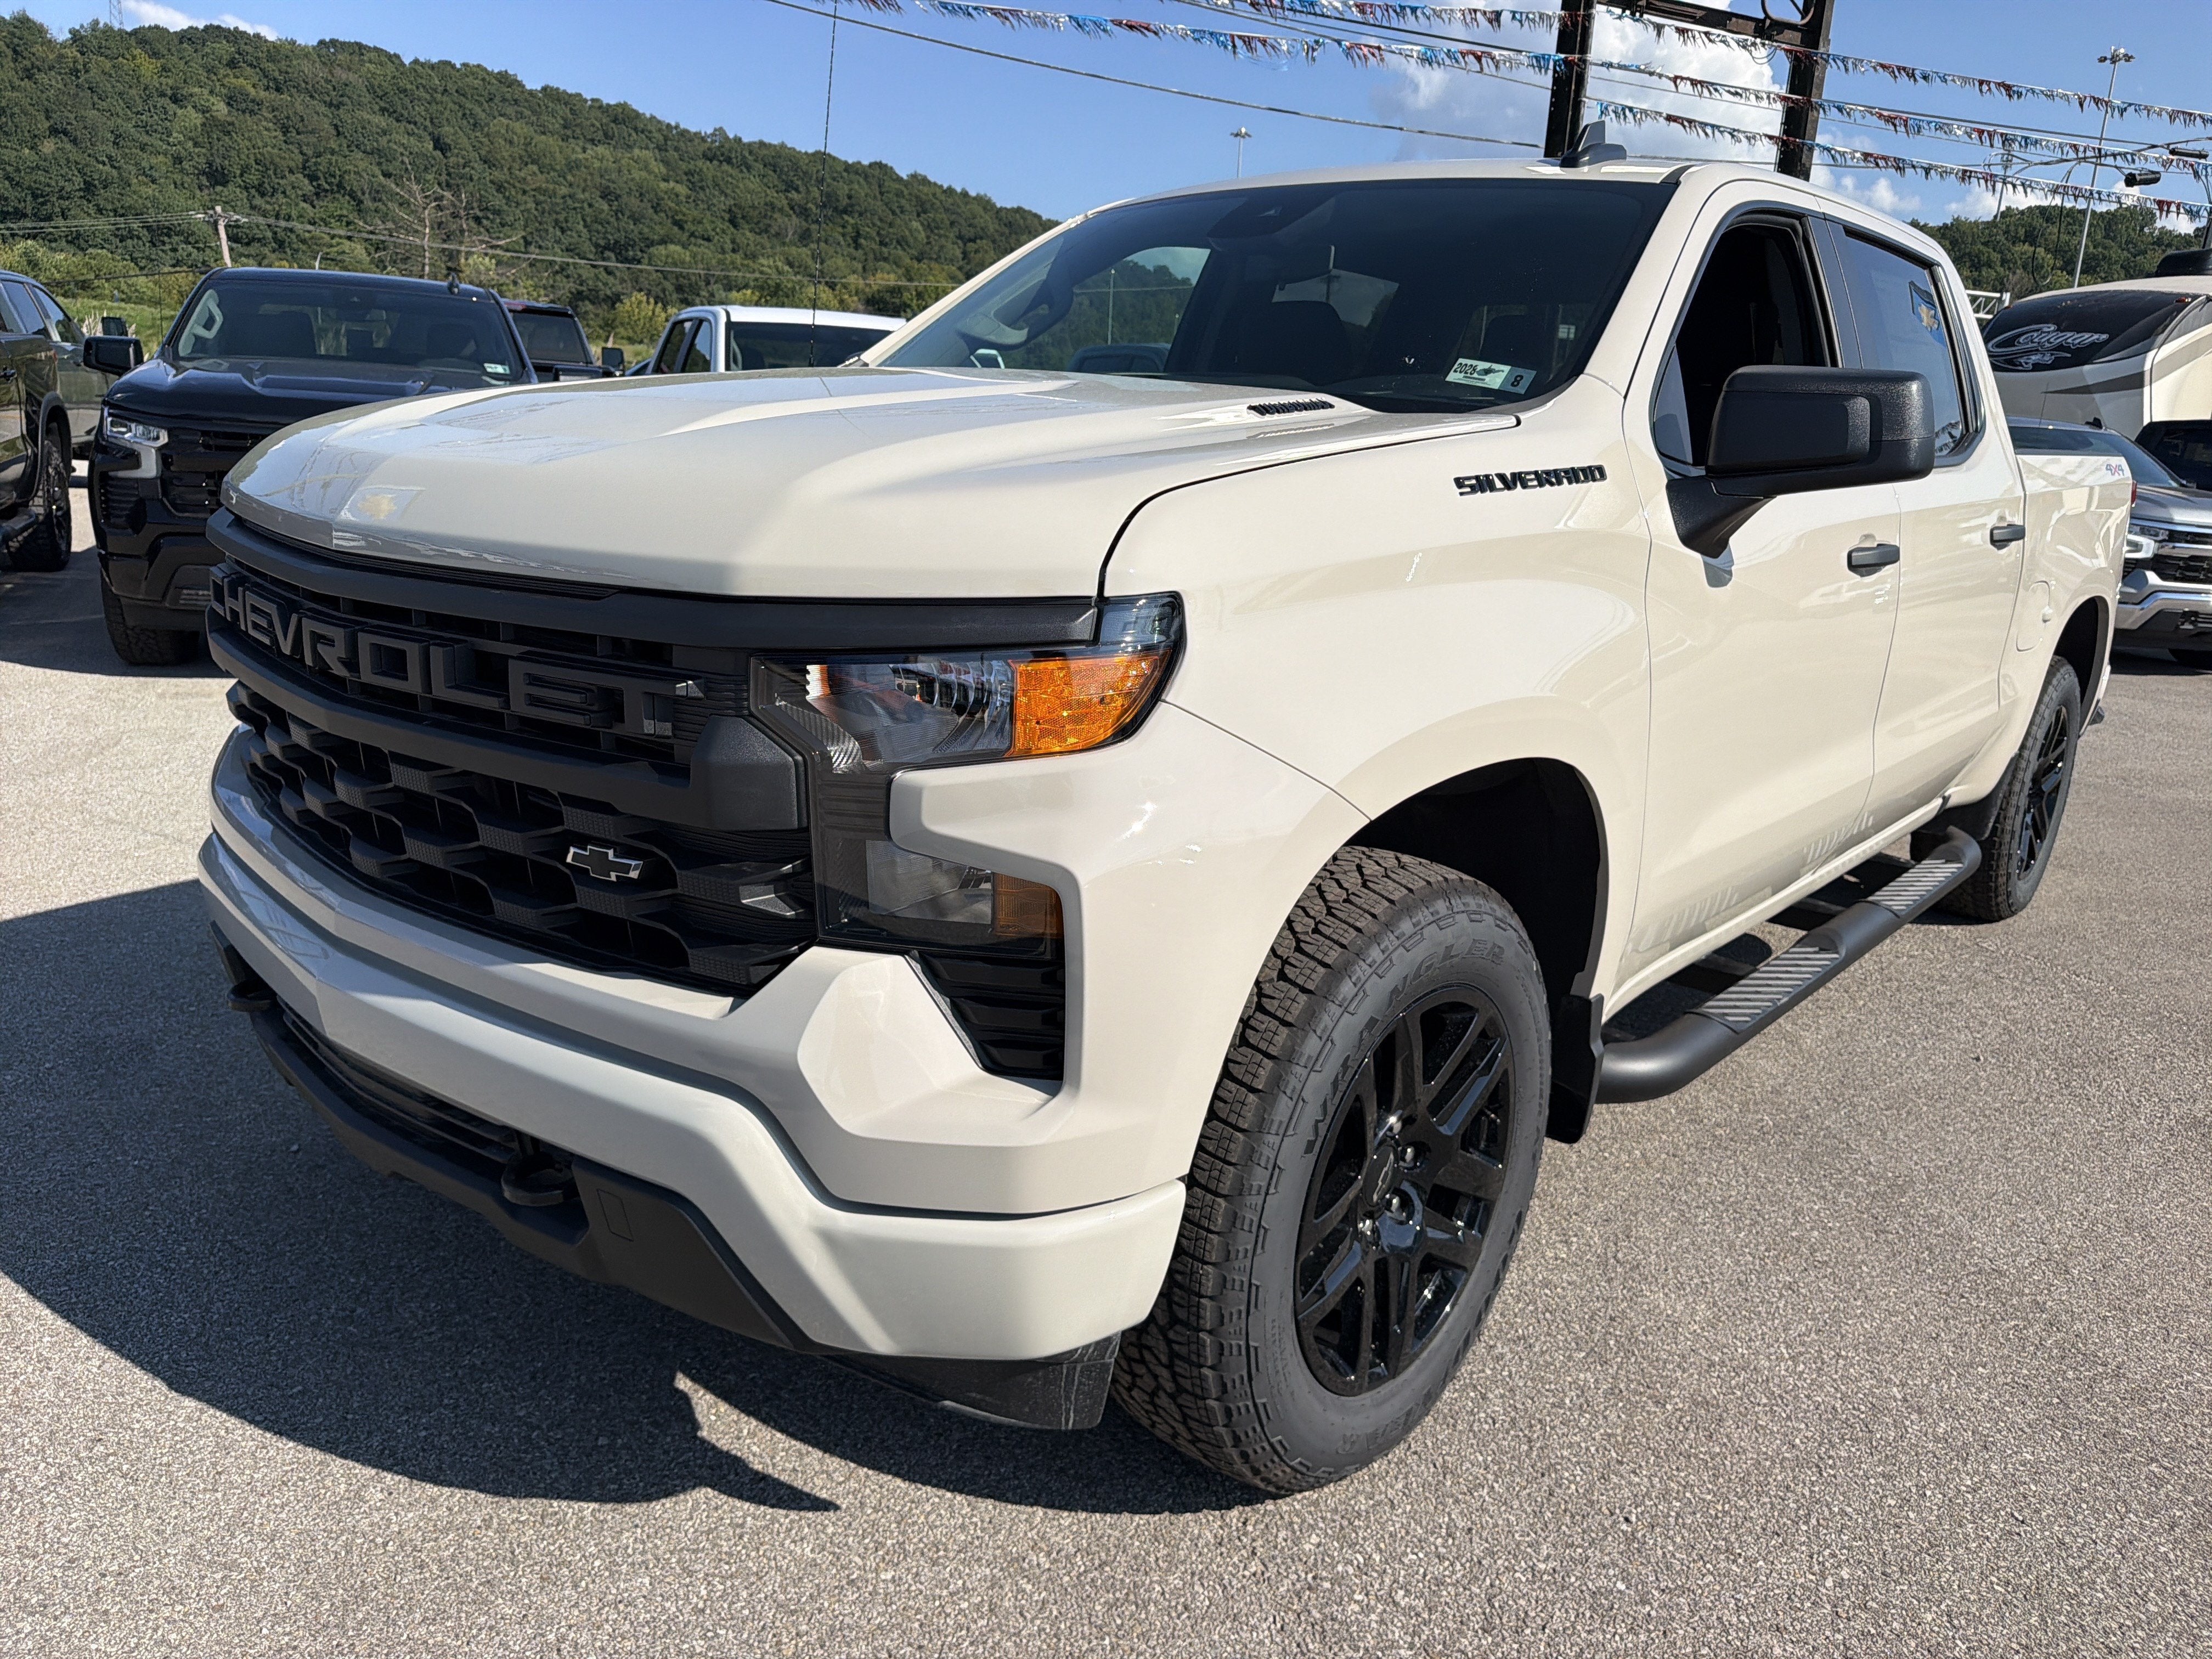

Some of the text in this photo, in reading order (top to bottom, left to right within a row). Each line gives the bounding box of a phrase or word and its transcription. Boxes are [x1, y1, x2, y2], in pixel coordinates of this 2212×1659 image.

[1988, 324, 2109, 353] Cougar
[1510, 374, 1524, 387] 8
[1454, 465, 1608, 496] SILVERADO
[210, 563, 706, 738] CHEVROLET
[1300, 938, 1506, 1159] WRANGLER
